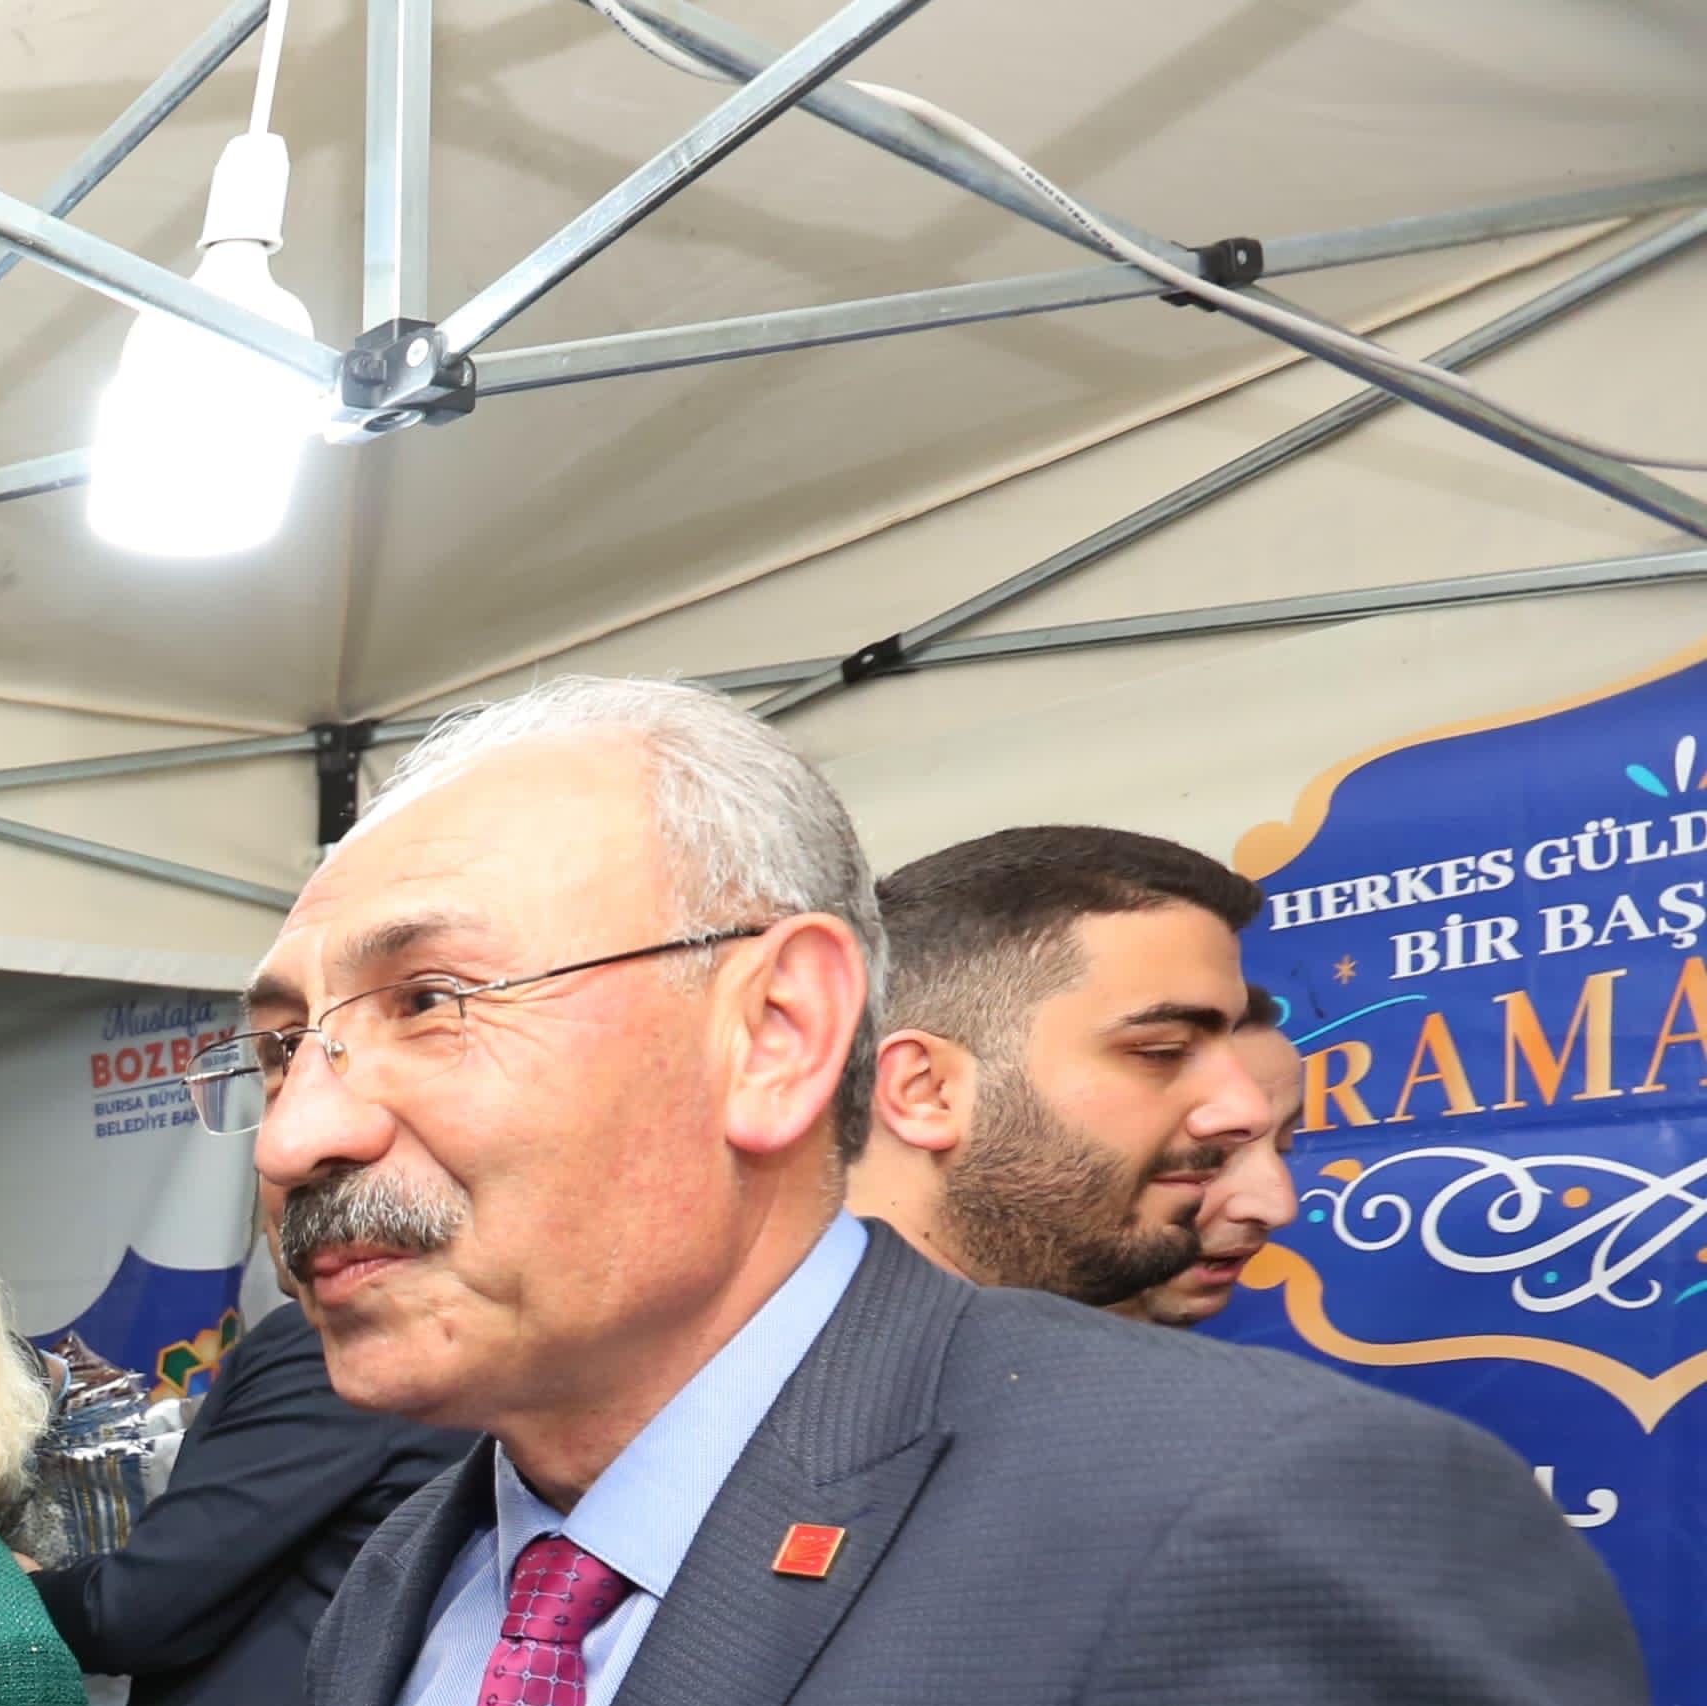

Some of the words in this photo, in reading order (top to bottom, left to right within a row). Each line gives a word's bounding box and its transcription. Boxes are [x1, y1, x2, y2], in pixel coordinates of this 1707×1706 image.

[1268, 849, 1515, 931] HERKES
[1389, 913, 1523, 980] BİR
[1539, 881, 1706, 956] BAŞ
[1293, 956, 1707, 1135] RAMA
[95, 1096, 144, 1117] BURSA
[96, 1112, 167, 1138] BELEDİYE
